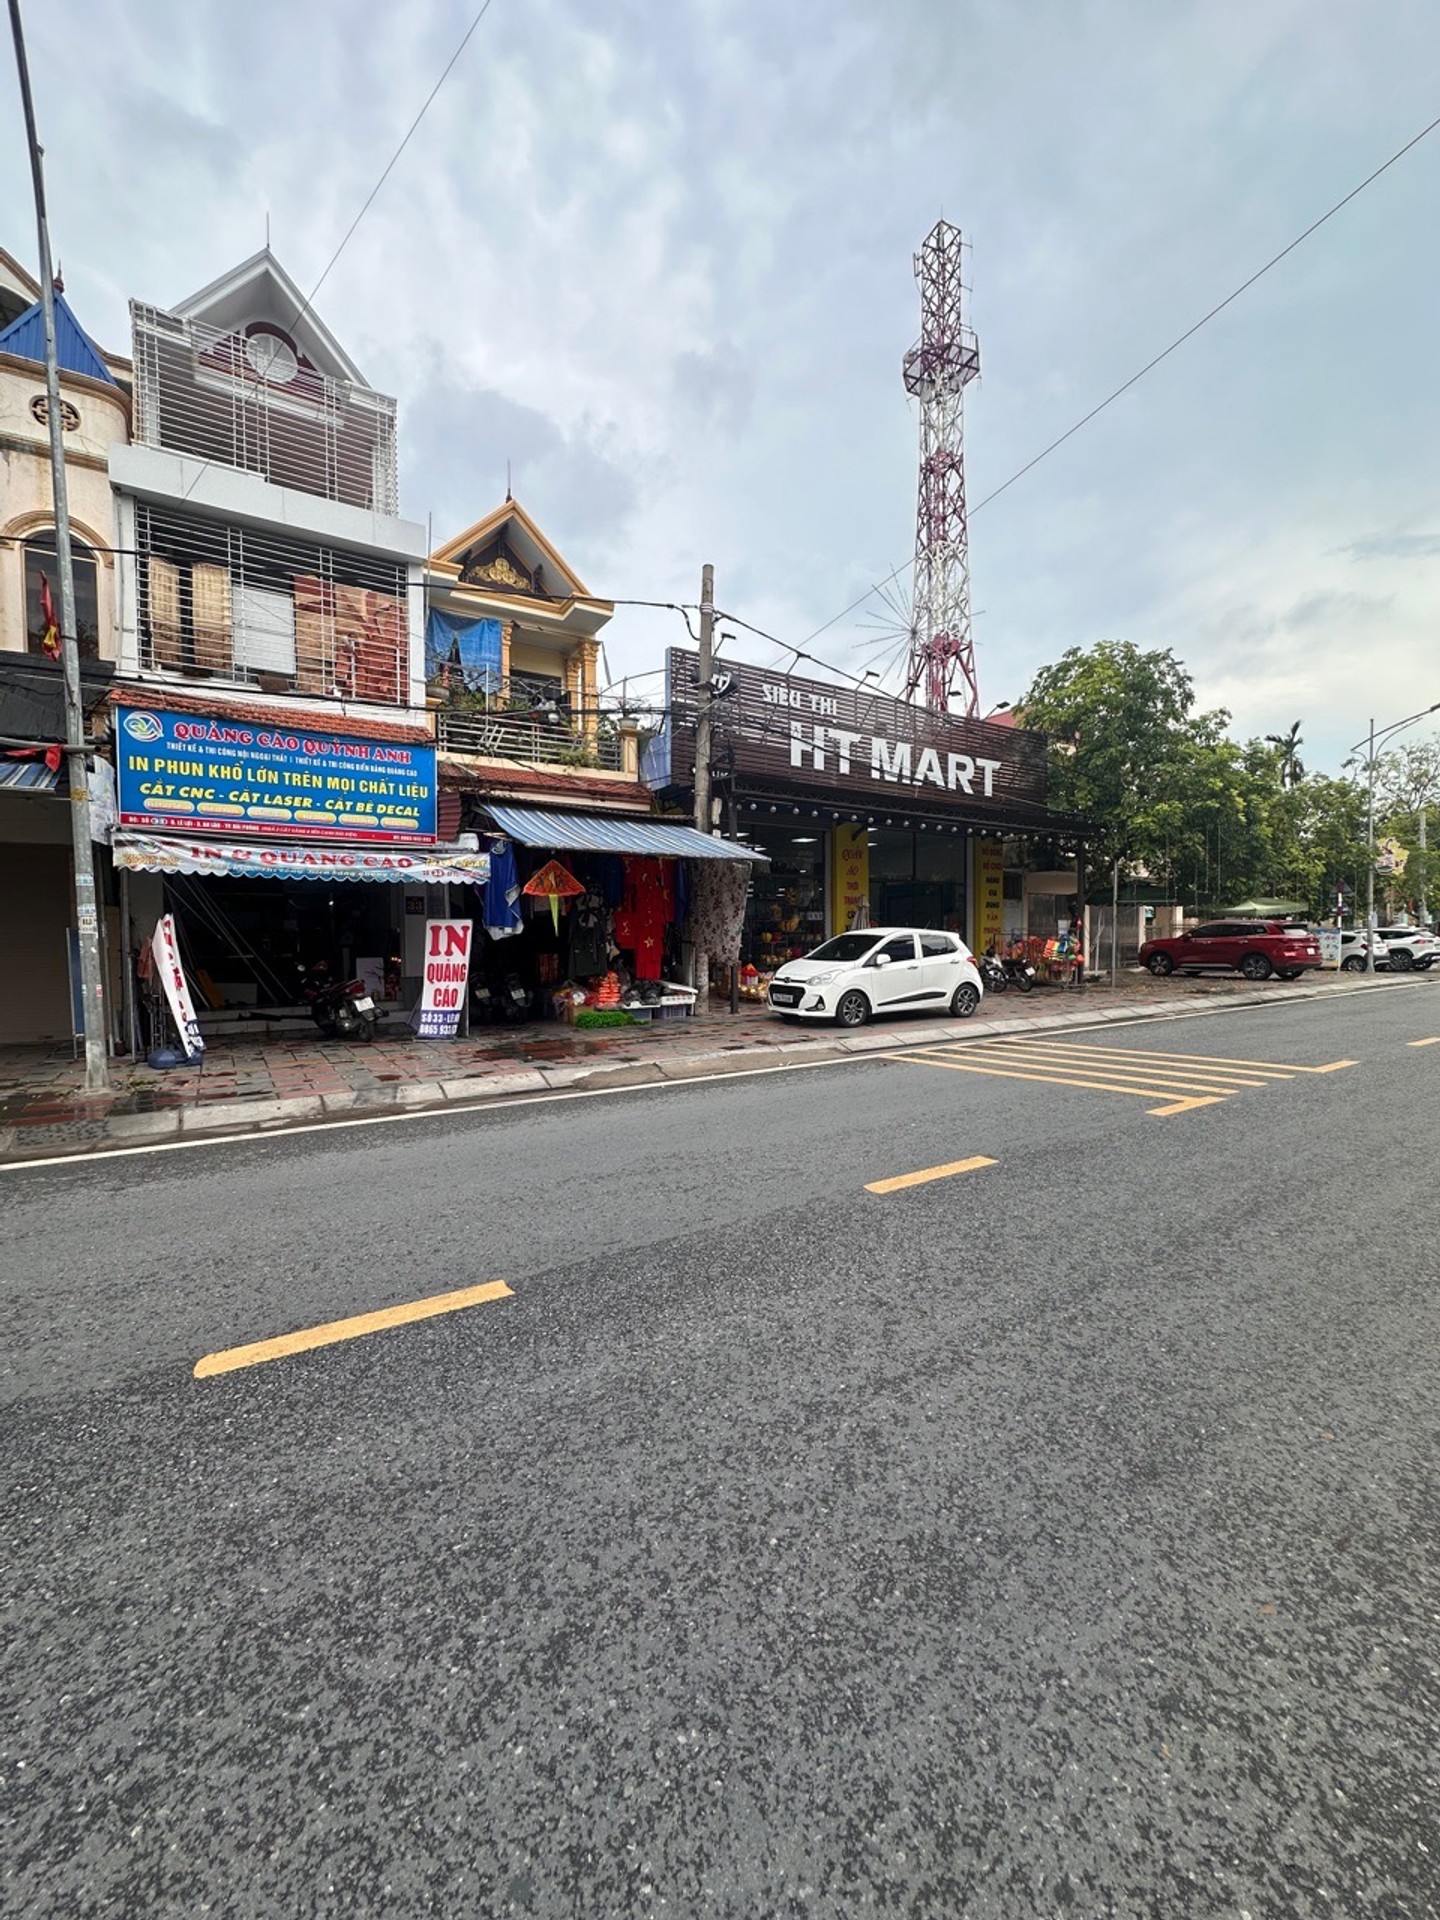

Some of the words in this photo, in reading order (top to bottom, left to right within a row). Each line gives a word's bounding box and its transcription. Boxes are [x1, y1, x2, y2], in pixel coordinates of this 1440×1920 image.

[174, 720, 253, 745] QUẢNG
[372, 746, 411, 765] ANH
[129, 755, 149, 771] IN
[154, 758, 204, 777] PHUN
[208, 760, 243, 780] KHỔ
[247, 765, 279, 784] LỚN
[283, 770, 322, 789] TRÊN
[326, 777, 355, 795] MỌI
[359, 777, 395, 795] CHẤT
[398, 781, 429, 800] LIỆU
[871, 737, 1001, 798] MART
[179, 786, 215, 799] CNC
[263, 793, 312, 808] LASER
[376, 804, 421, 817] DECAL
[191, 846, 222, 860] IN
[429, 925, 470, 956] IN
[427, 959, 467, 984] QUẢNG
[433, 984, 458, 1008] CÁO
